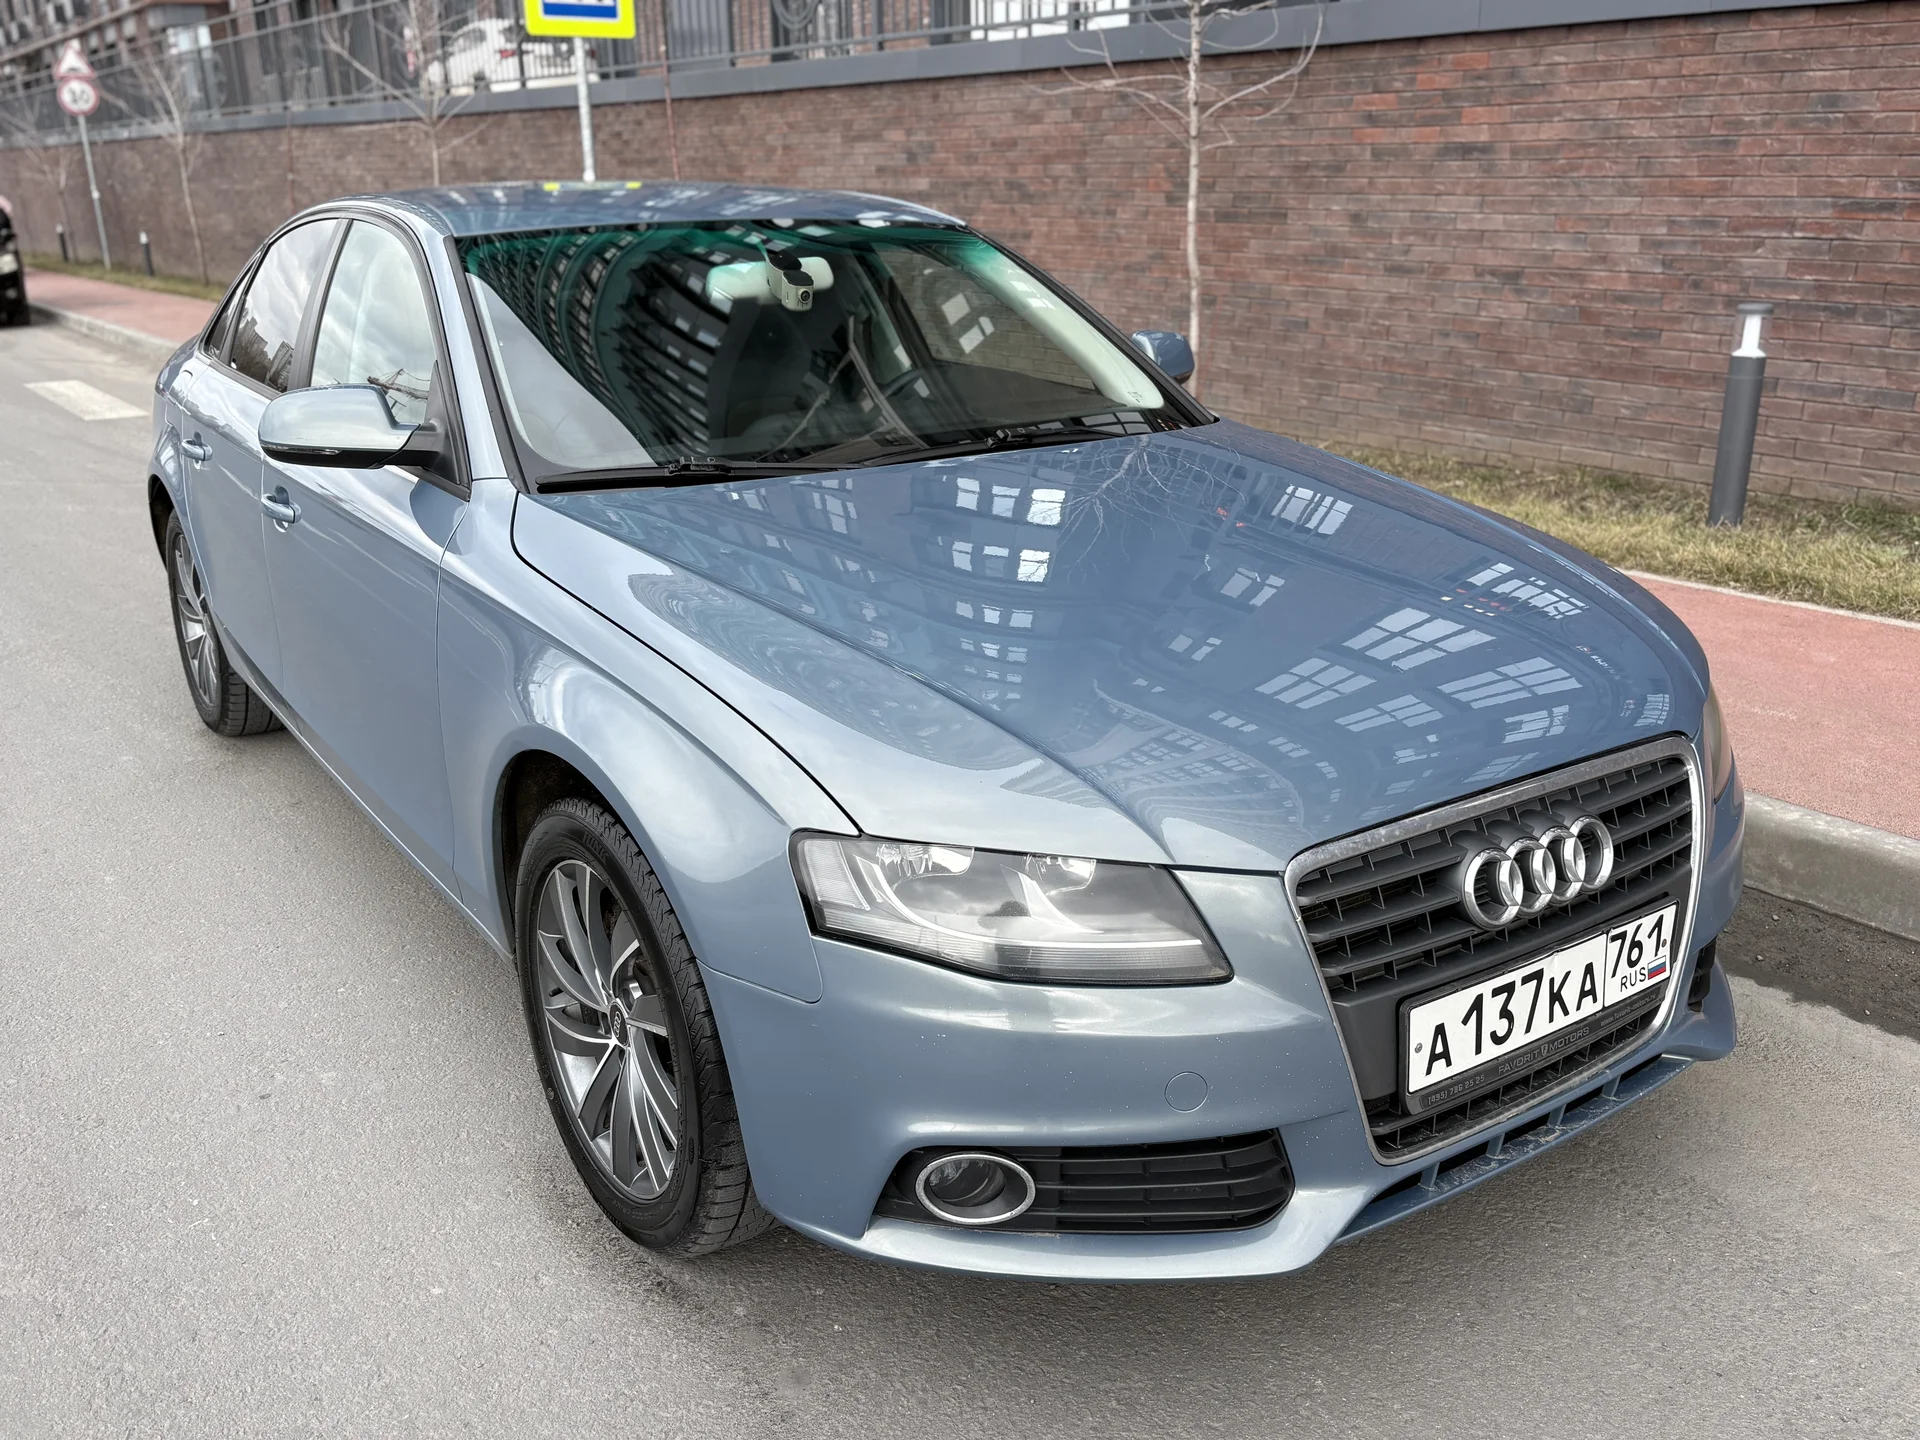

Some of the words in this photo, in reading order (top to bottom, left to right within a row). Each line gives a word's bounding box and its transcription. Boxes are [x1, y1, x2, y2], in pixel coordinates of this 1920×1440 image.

[1609, 914, 1664, 979] 761
[1620, 966, 1647, 993] RUS
[1498, 1049, 1540, 1075] FAVORIT
[1549, 1026, 1589, 1052] MOTORS
